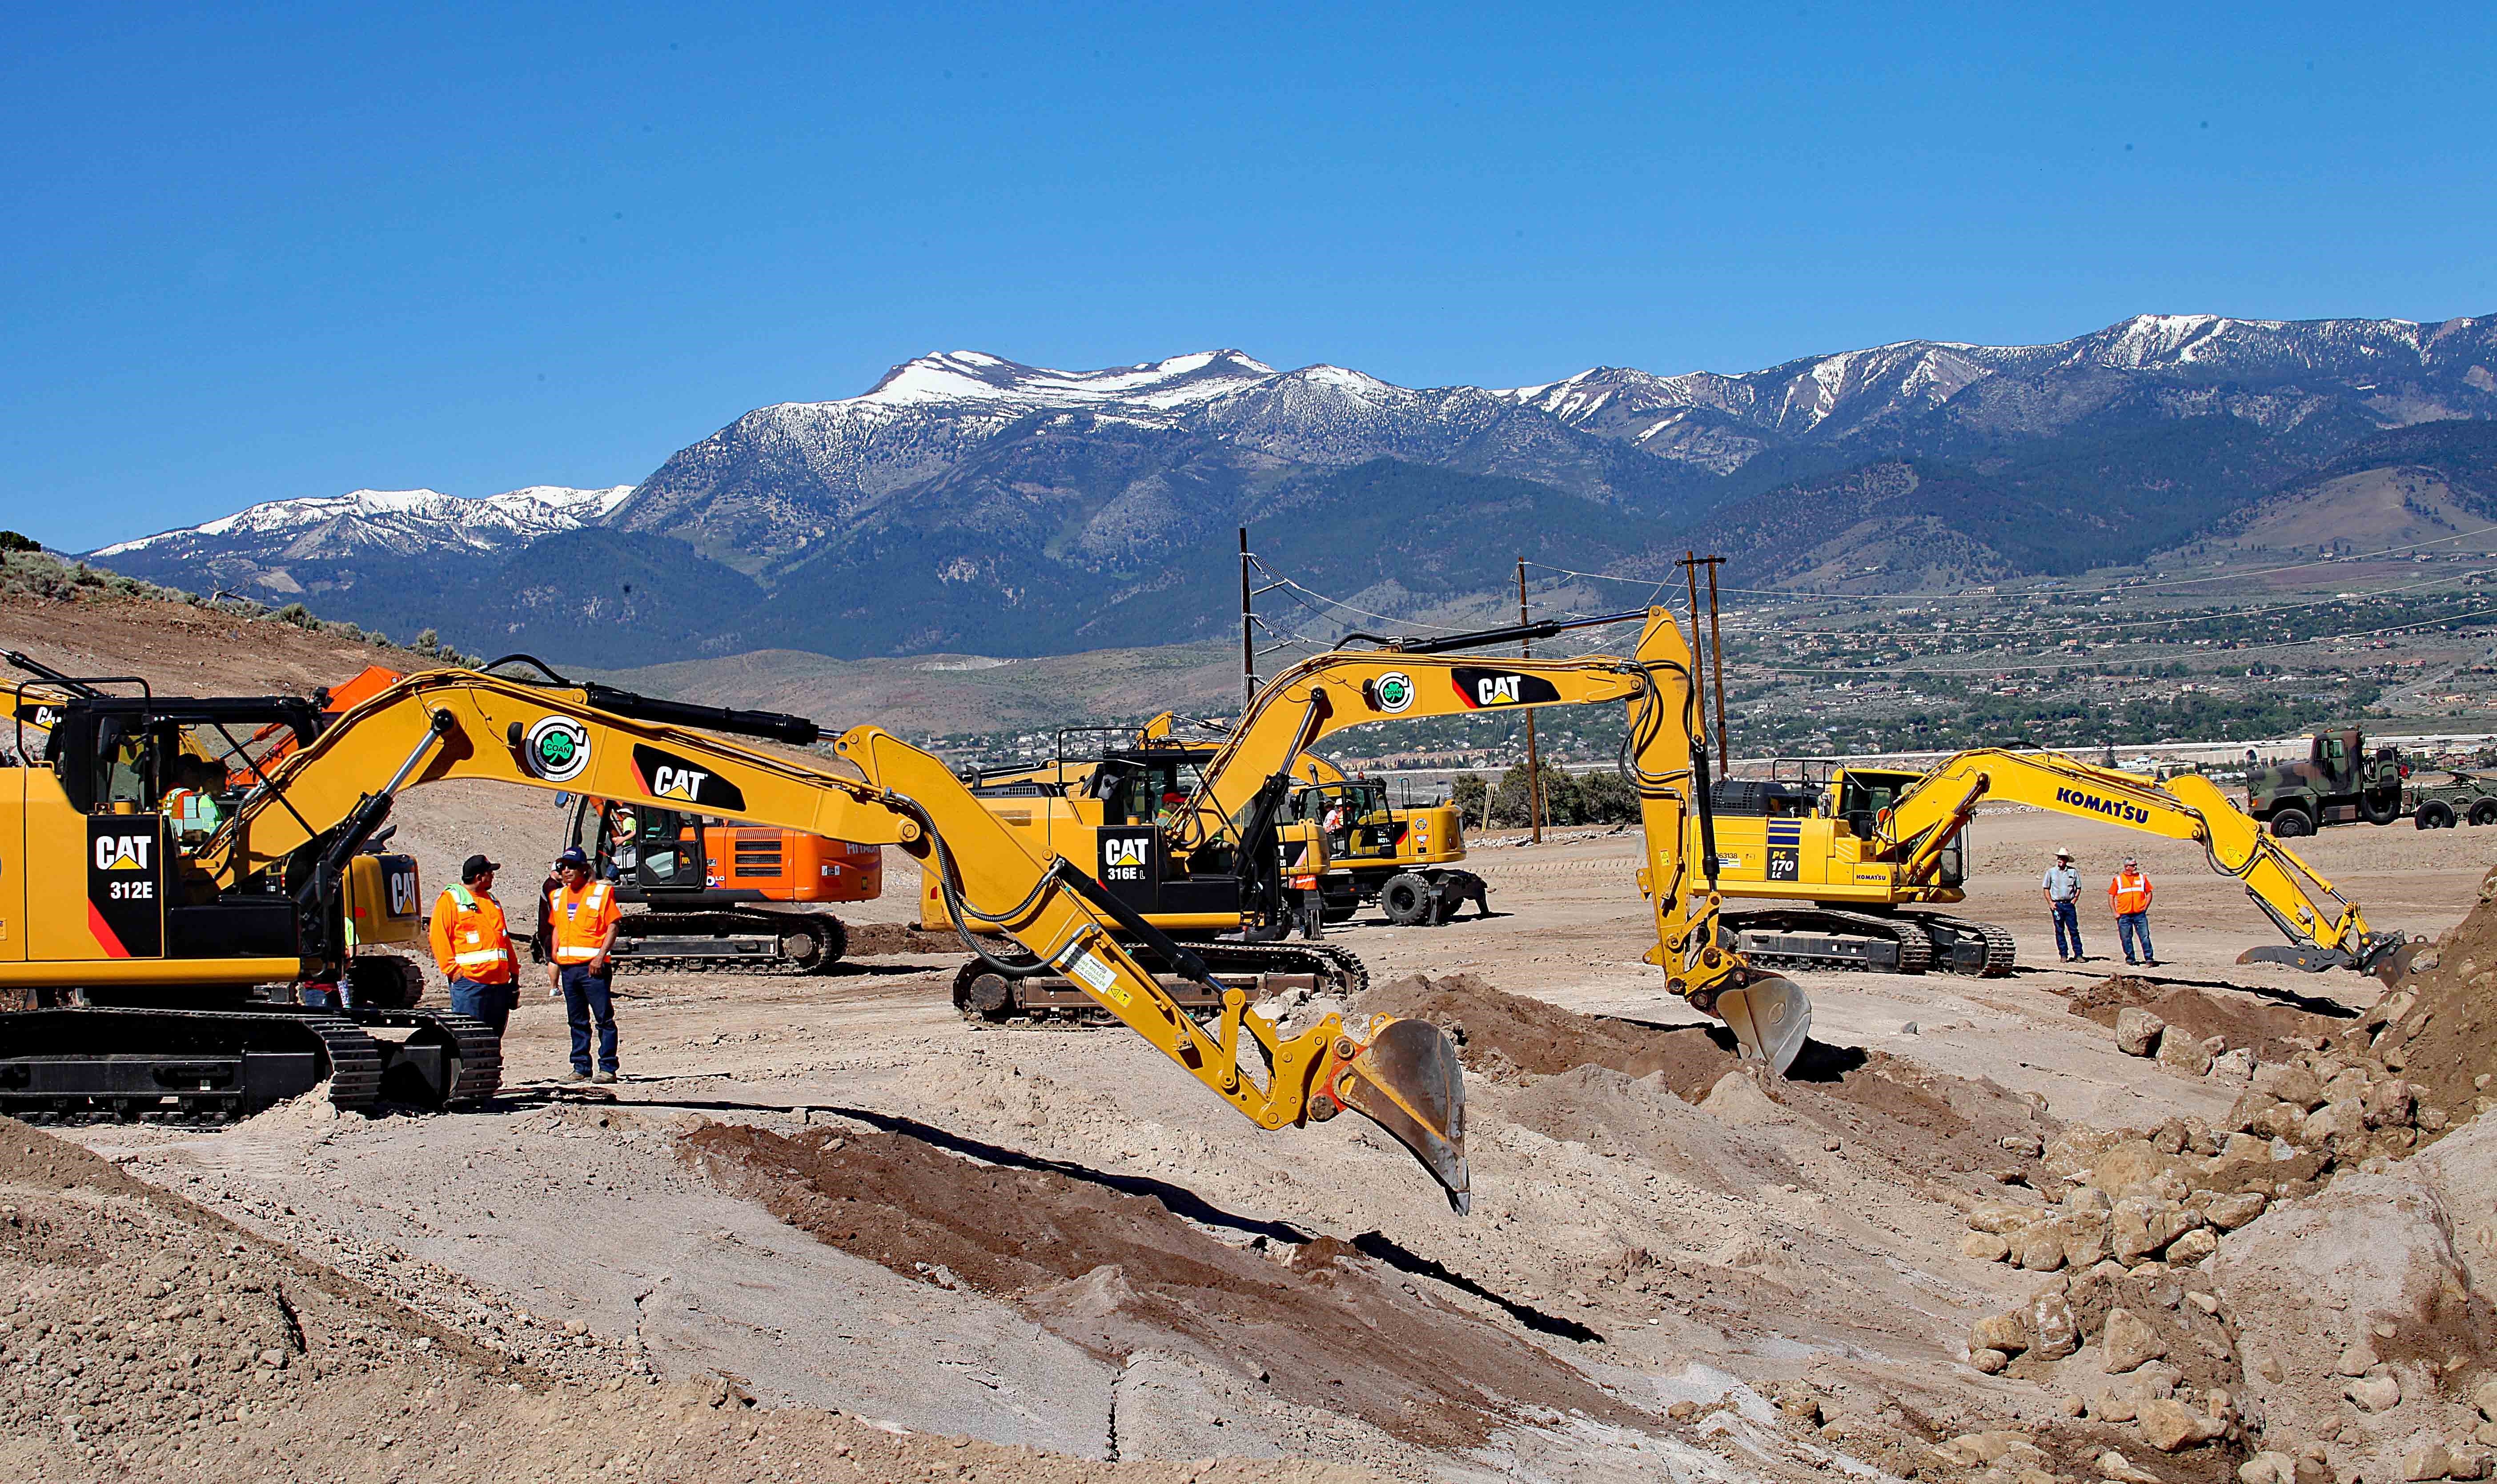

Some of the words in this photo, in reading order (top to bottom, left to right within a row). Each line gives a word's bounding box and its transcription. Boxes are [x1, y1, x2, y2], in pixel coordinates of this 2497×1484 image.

[1478, 675, 1521, 705] CAT
[36, 706, 62, 724] CA
[546, 744, 570, 754] COAN
[654, 766, 705, 801] CAT
[2056, 787, 2149, 823] KOMATSU
[96, 835, 152, 870] CAT
[1105, 838, 1149, 866] CAT
[1772, 850, 1786, 859] PC
[1108, 867, 1137, 879] 316E
[1771, 860, 1794, 871] 170
[110, 881, 153, 899] 312E
[391, 872, 417, 914] CAT
[1084, 970, 1106, 987] COUPLER
[1088, 966, 1106, 980] MILLER
